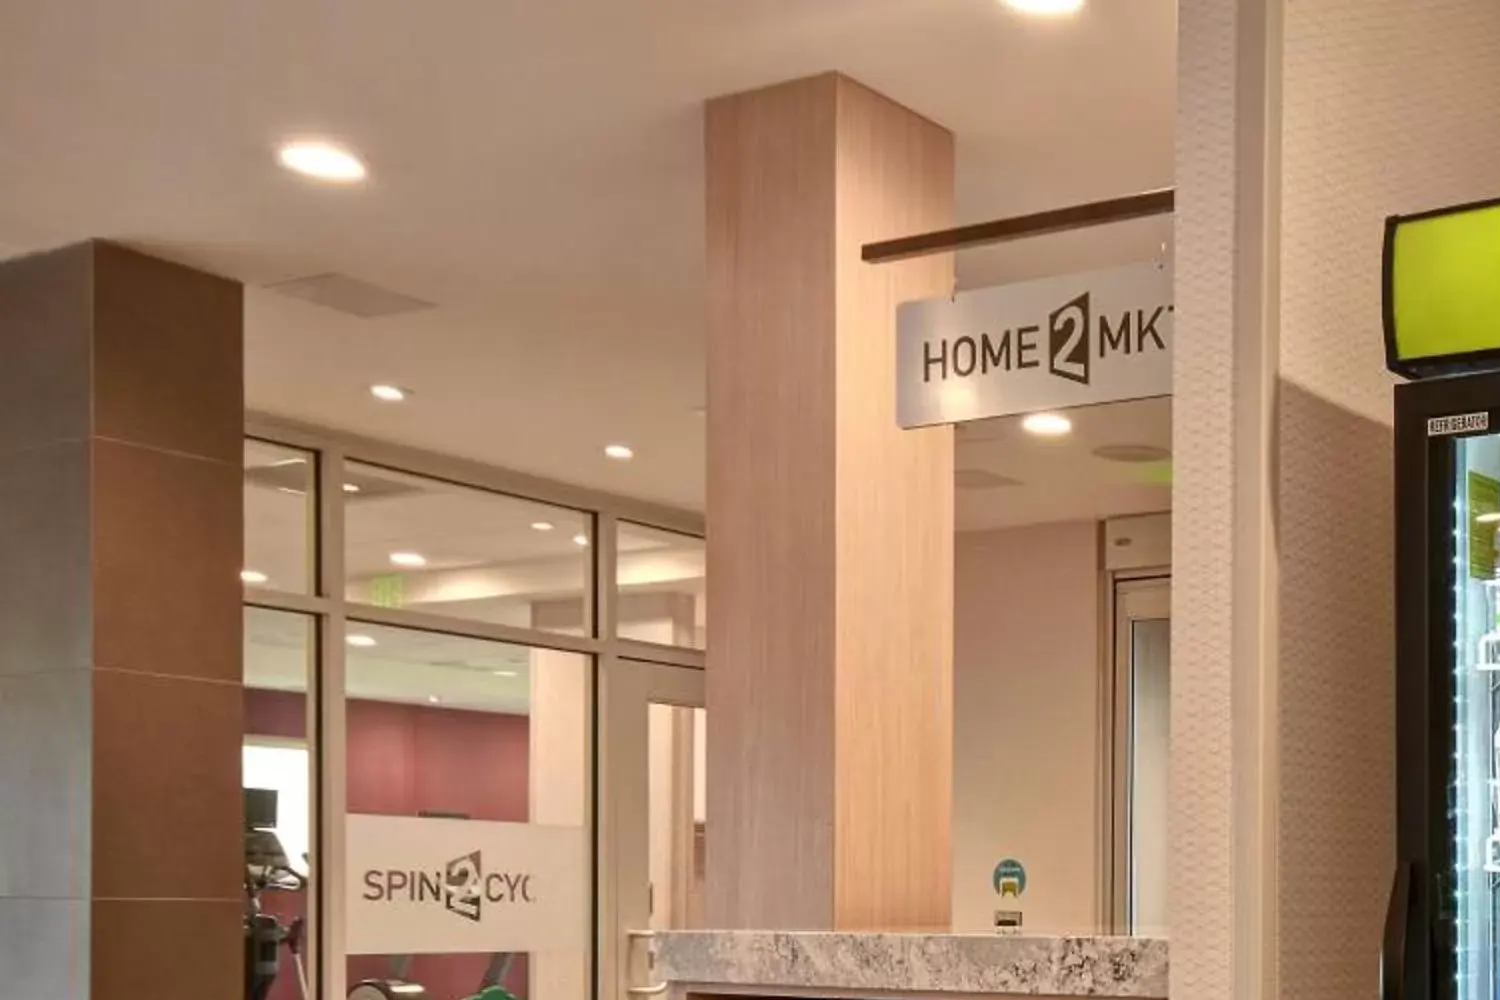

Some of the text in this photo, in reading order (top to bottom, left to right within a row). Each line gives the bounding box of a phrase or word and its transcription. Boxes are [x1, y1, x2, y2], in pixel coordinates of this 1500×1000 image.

[923, 325, 1040, 382] HOME
[1099, 304, 1175, 358] MK
[363, 869, 441, 902] SPIN
